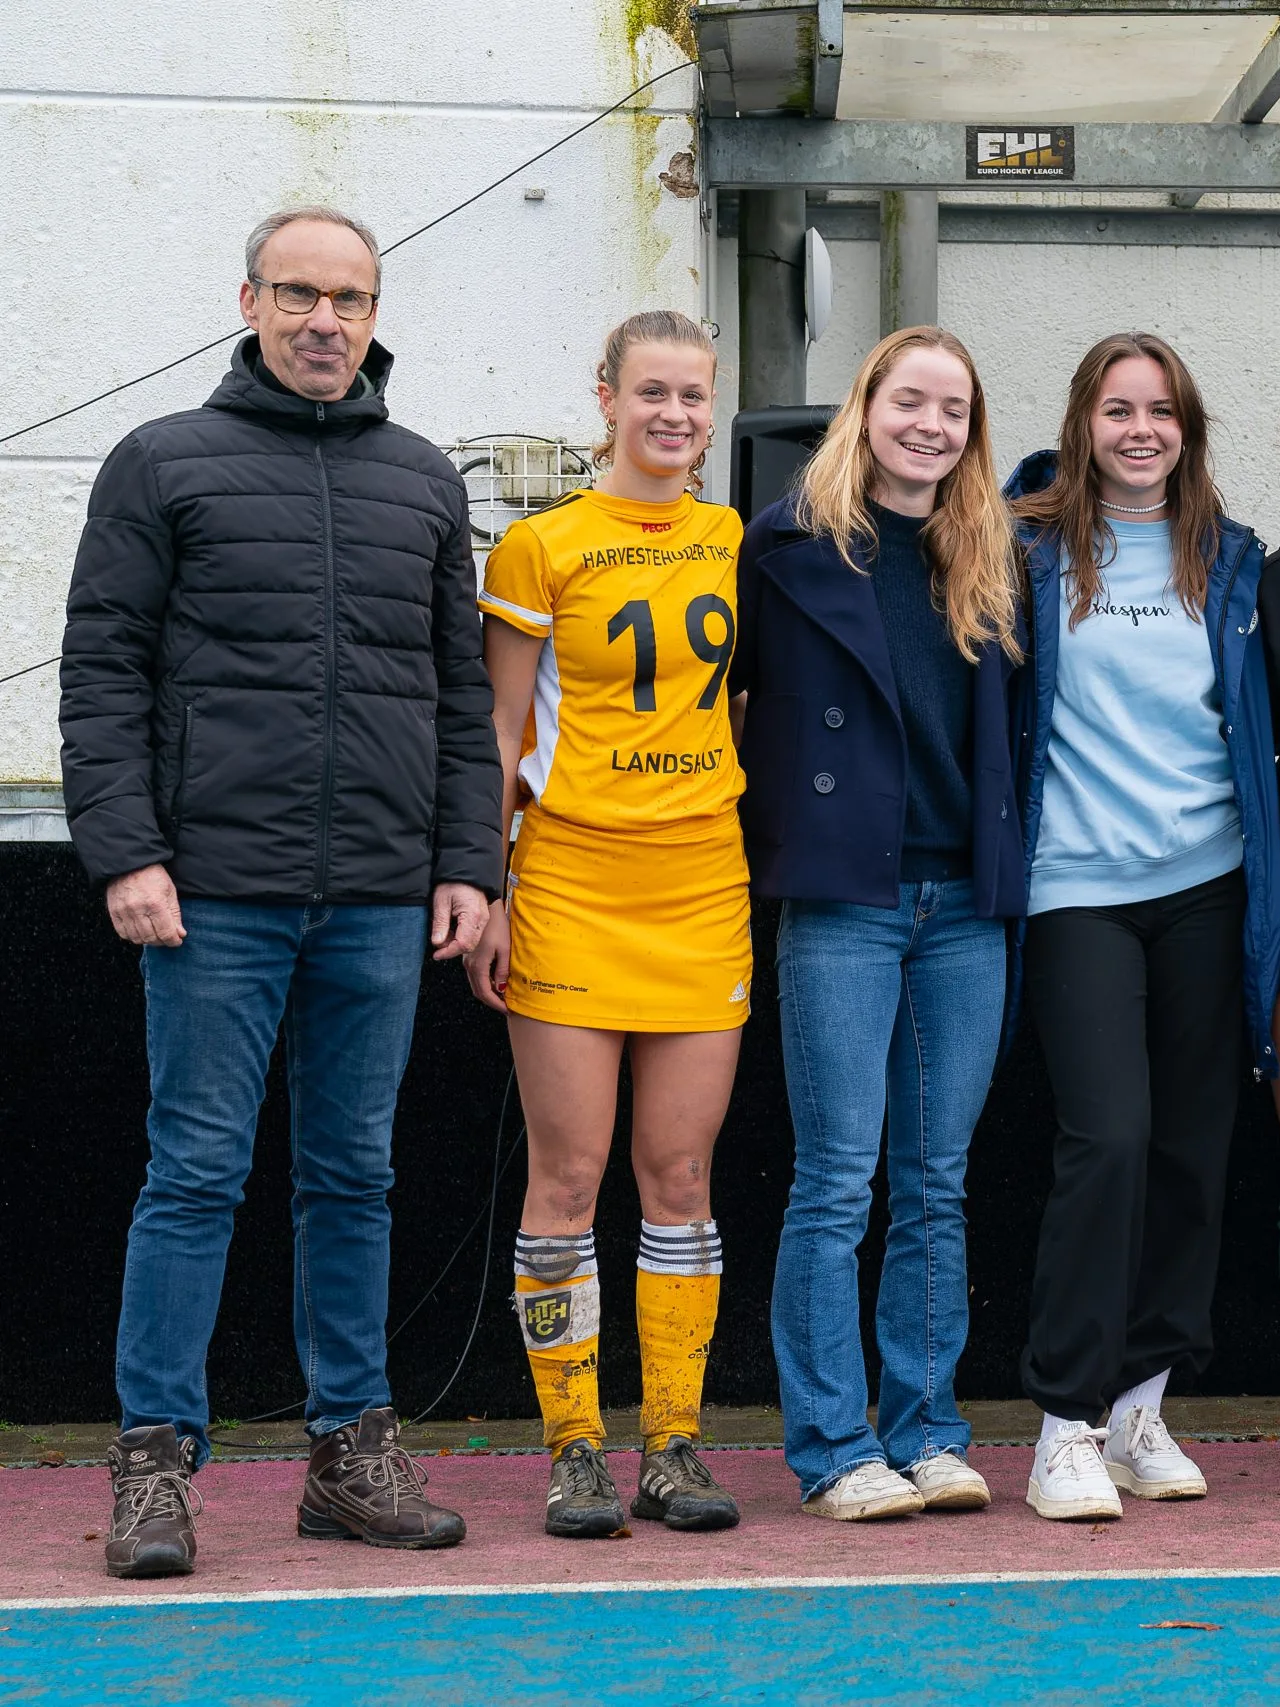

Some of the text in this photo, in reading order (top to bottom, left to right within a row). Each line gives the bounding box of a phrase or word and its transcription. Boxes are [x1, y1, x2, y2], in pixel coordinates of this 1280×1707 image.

[977, 132, 1064, 167] EHL
[1093, 600, 1170, 627] Wespen
[607, 593, 735, 713] 19
[556, 983, 568, 991] City
